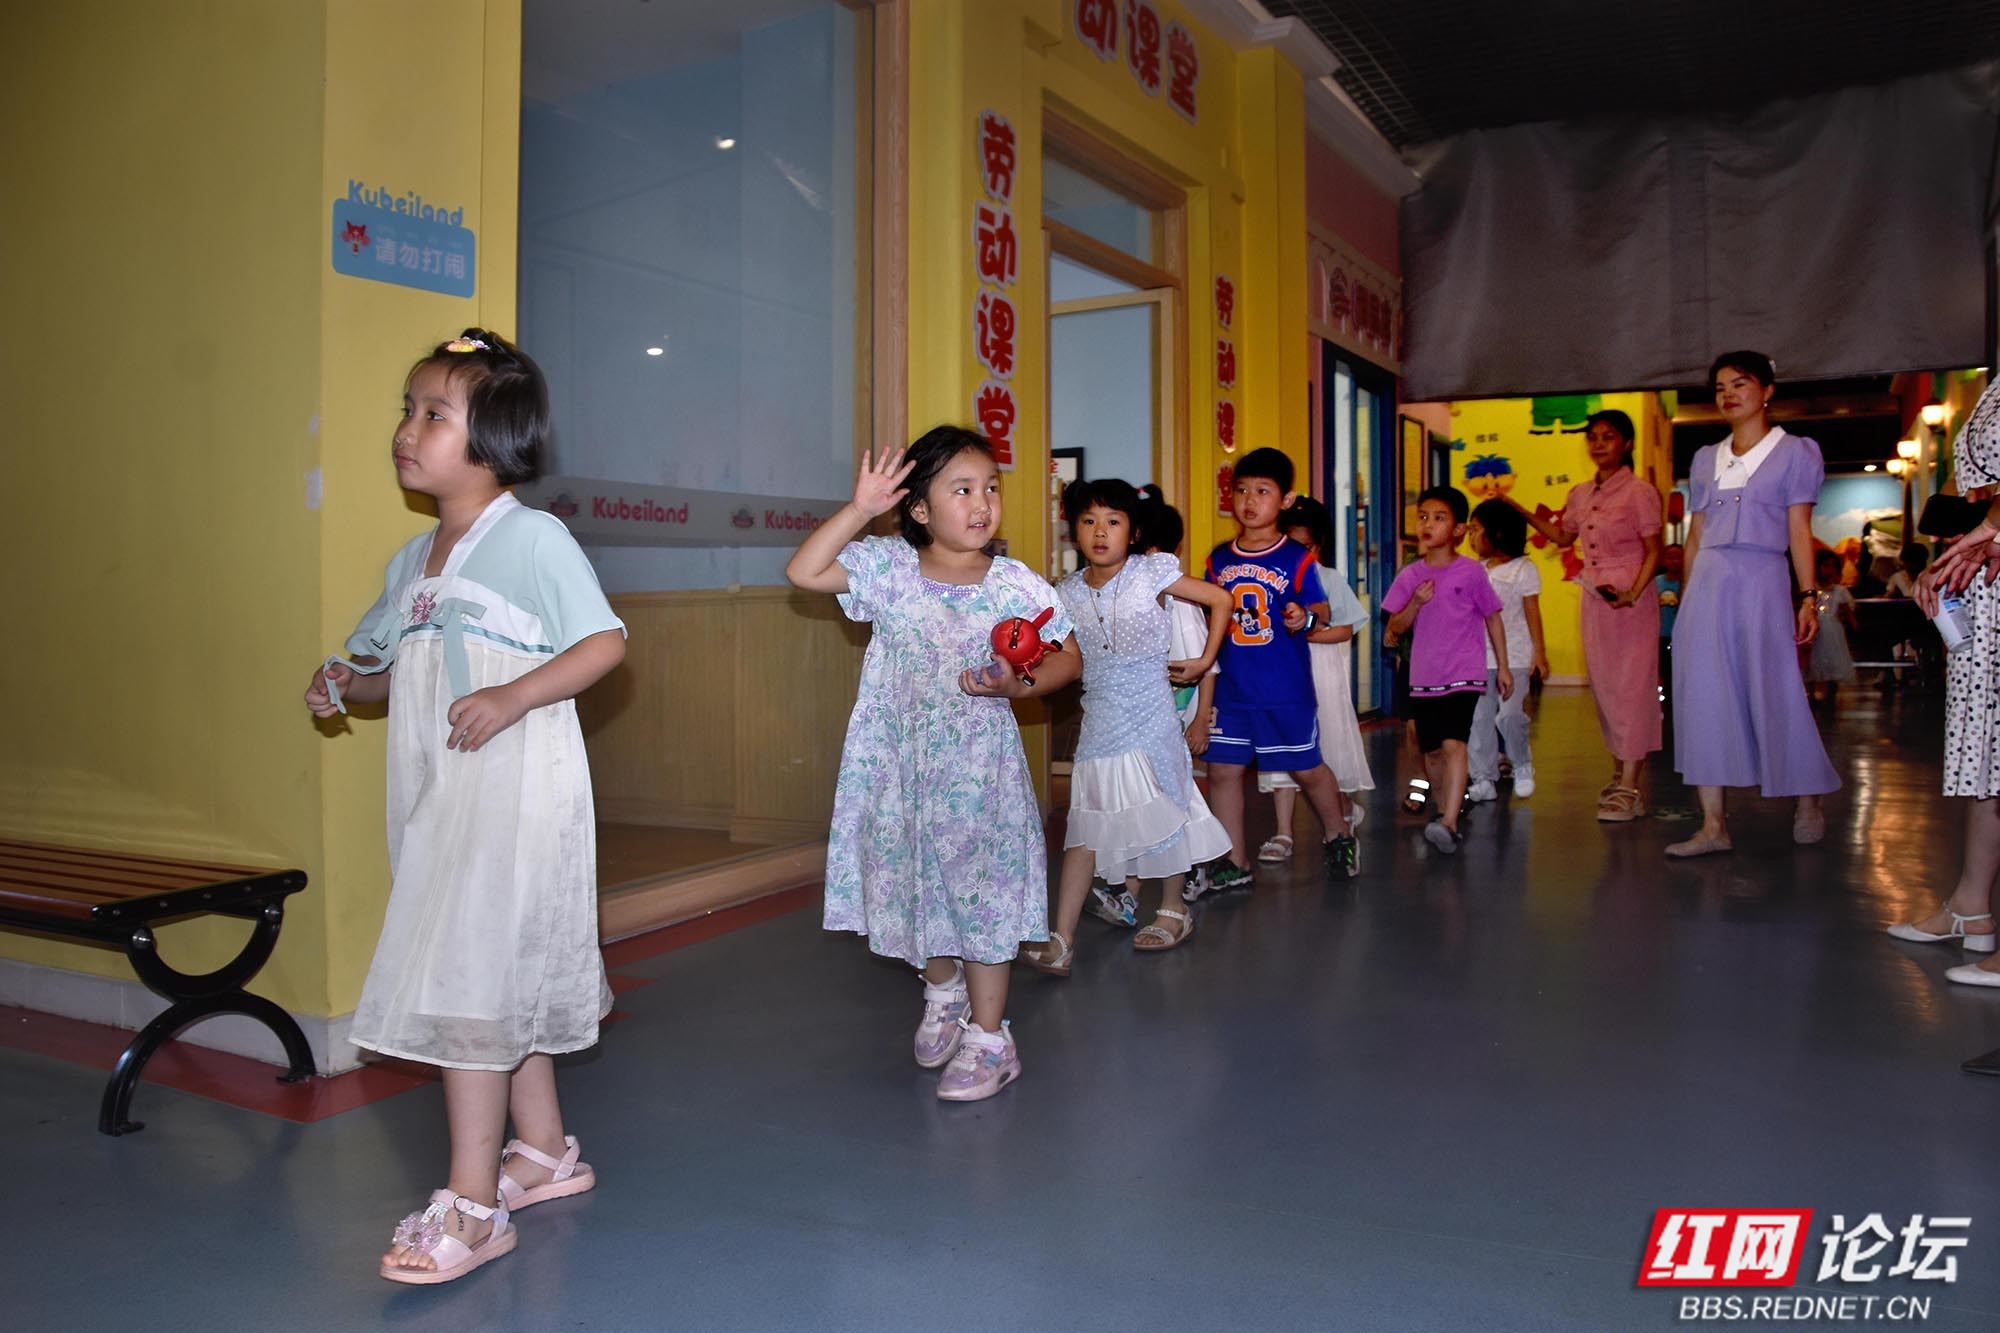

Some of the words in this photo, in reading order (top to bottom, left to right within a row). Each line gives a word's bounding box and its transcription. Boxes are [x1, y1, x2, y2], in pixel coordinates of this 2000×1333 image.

[348, 178, 463, 227] Kubeiland
[375, 236, 466, 280] 请勿打闹
[975, 112, 1018, 467] 劳动课堂
[592, 496, 688, 525] Kubeiland
[764, 510, 829, 531] Kubeila
